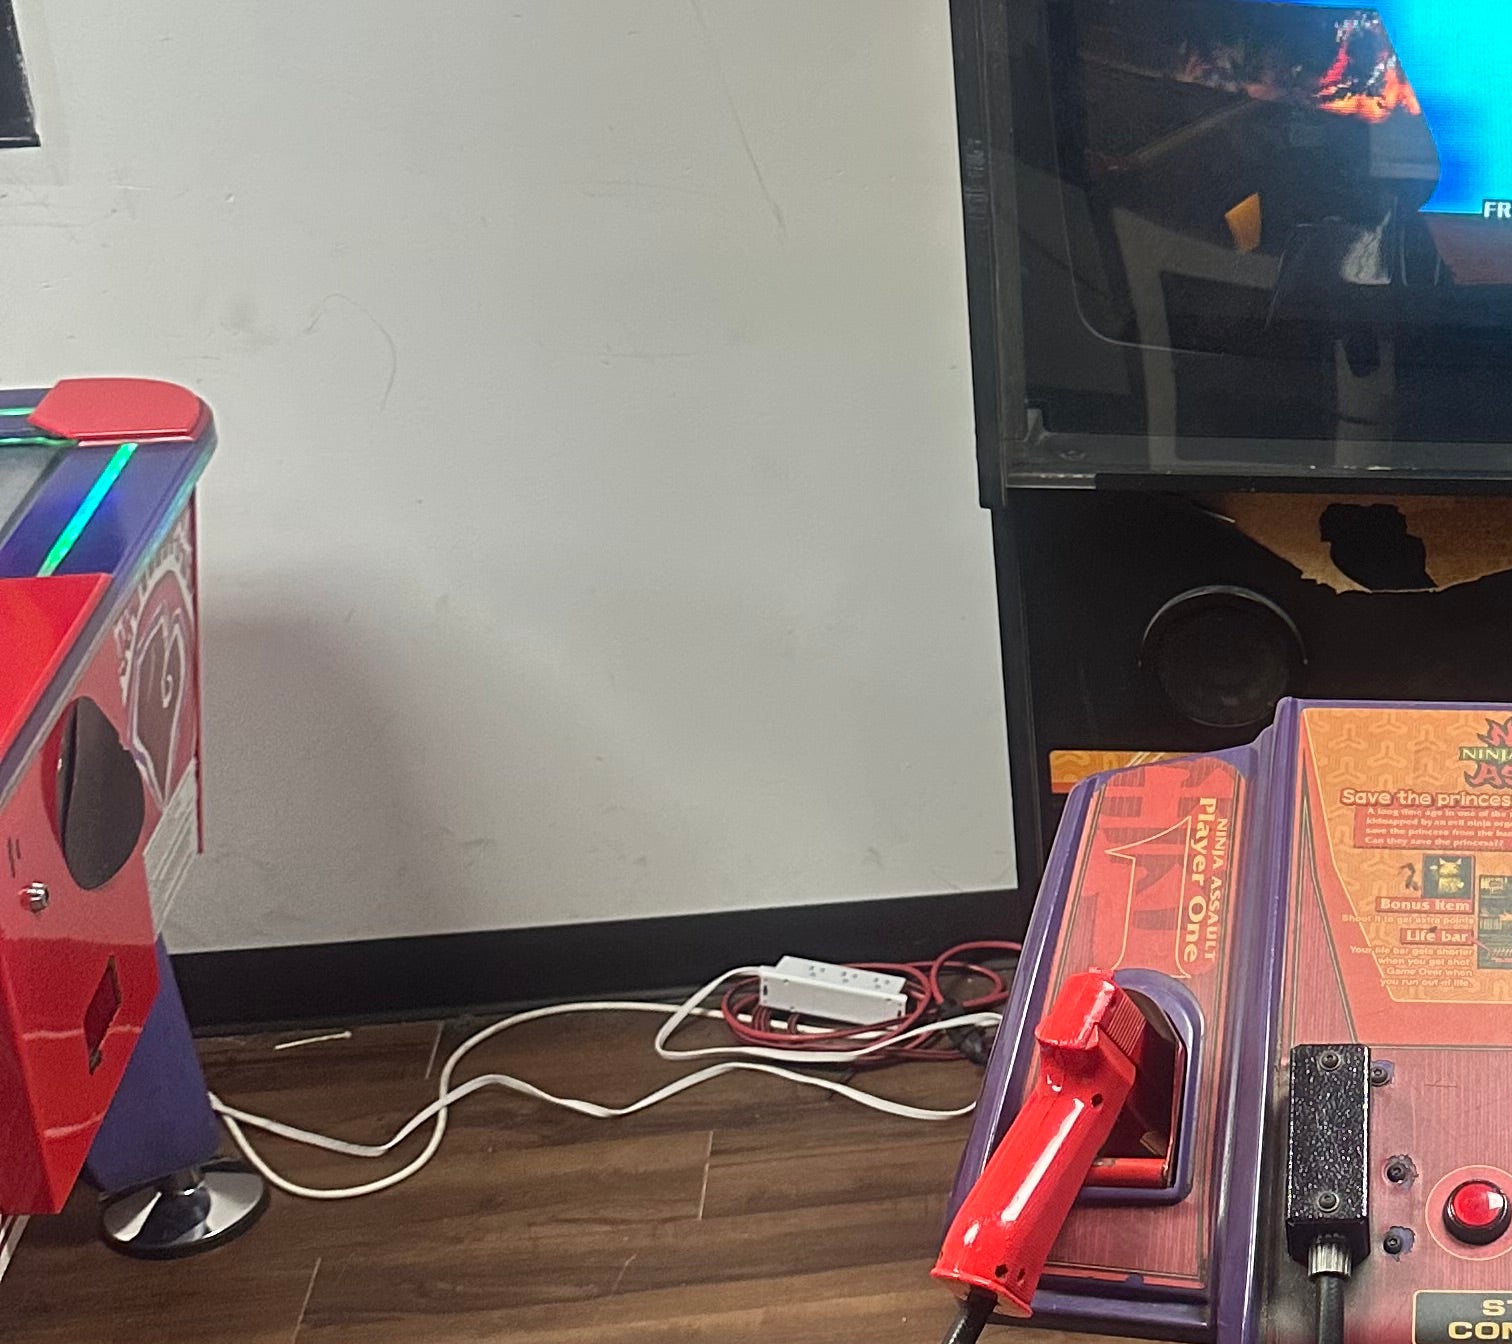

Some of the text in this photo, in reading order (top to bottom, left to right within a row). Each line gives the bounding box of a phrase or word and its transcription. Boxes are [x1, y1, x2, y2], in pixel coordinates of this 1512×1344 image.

[1341, 789, 1391, 805] Save
[1398, 790, 1432, 805] the
[1183, 797, 1217, 963] Player One
[1204, 817, 1229, 962] NINJA ASSAULT
[1380, 898, 1470, 911] Bonus Item
[1406, 929, 1469, 942] Life bar
